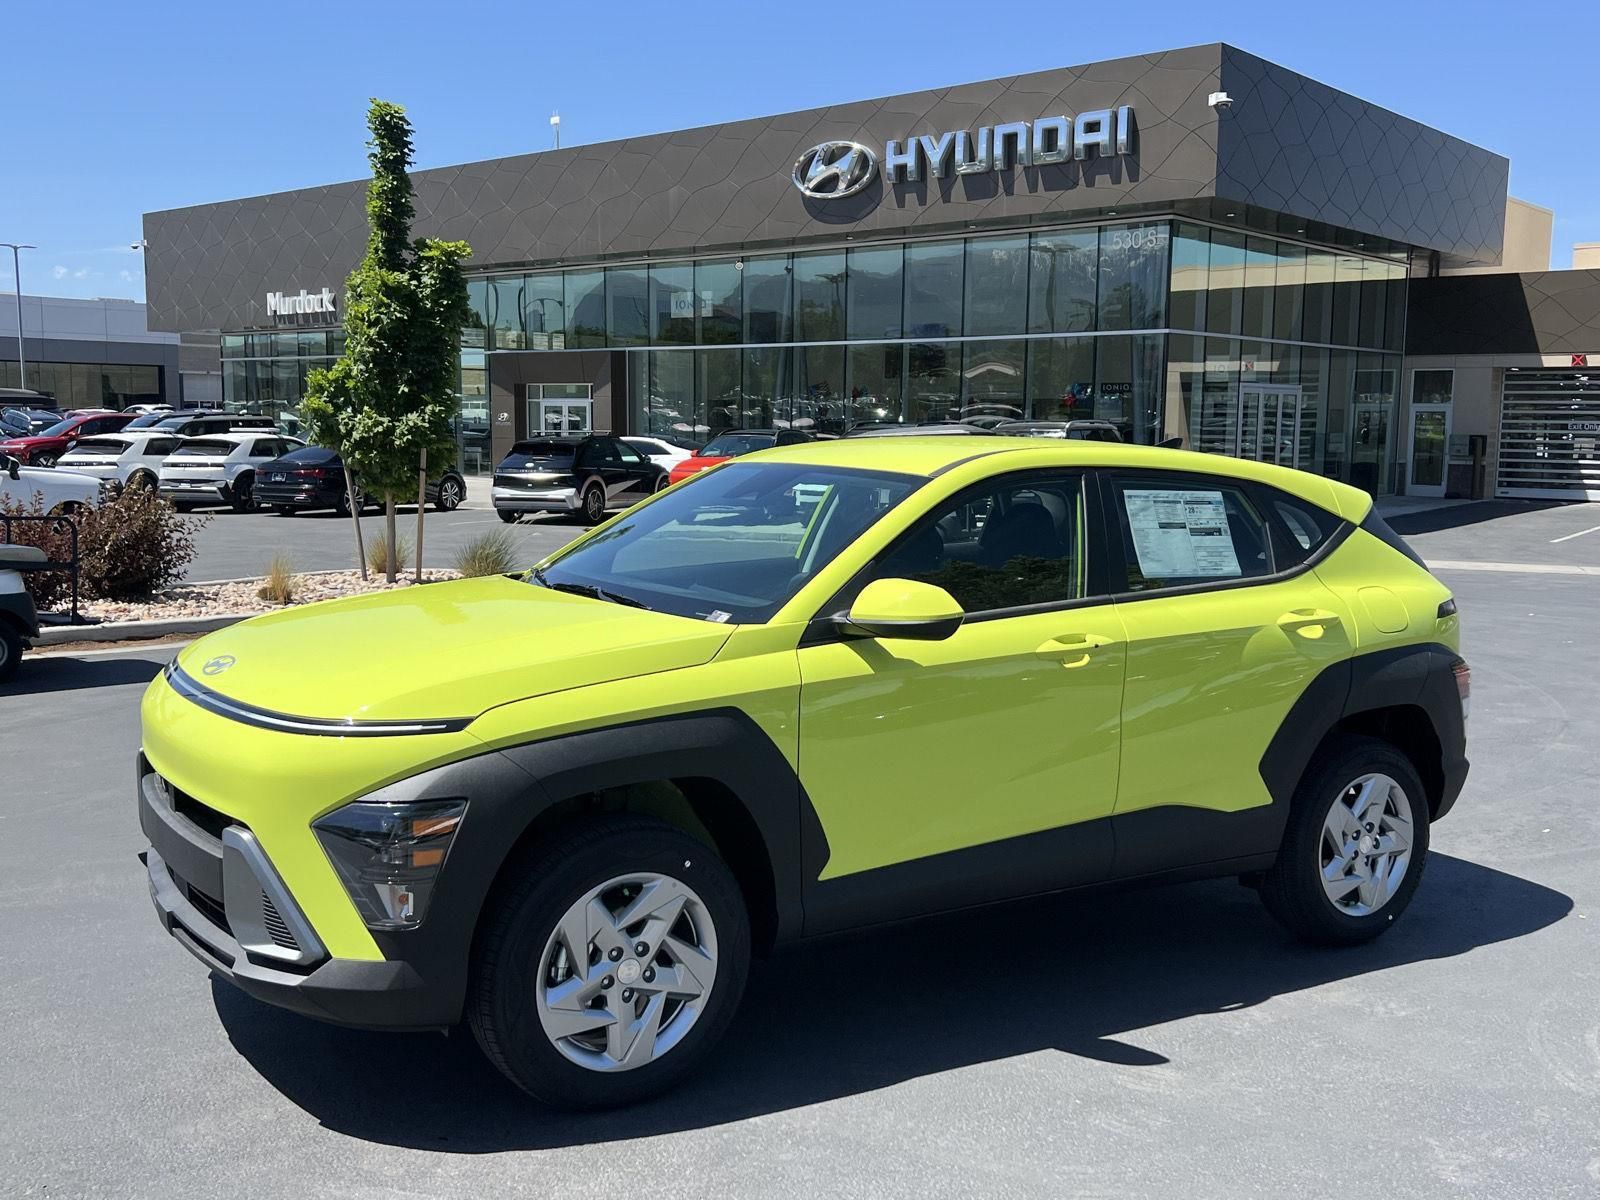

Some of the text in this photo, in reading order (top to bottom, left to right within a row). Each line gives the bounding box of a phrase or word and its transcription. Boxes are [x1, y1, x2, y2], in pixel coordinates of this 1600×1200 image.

[885, 105, 1135, 184] HYUNDAI
[1112, 231, 1142, 250] 530
[266, 287, 336, 316] Murdock
[1568, 423, 1583, 431] Exit
